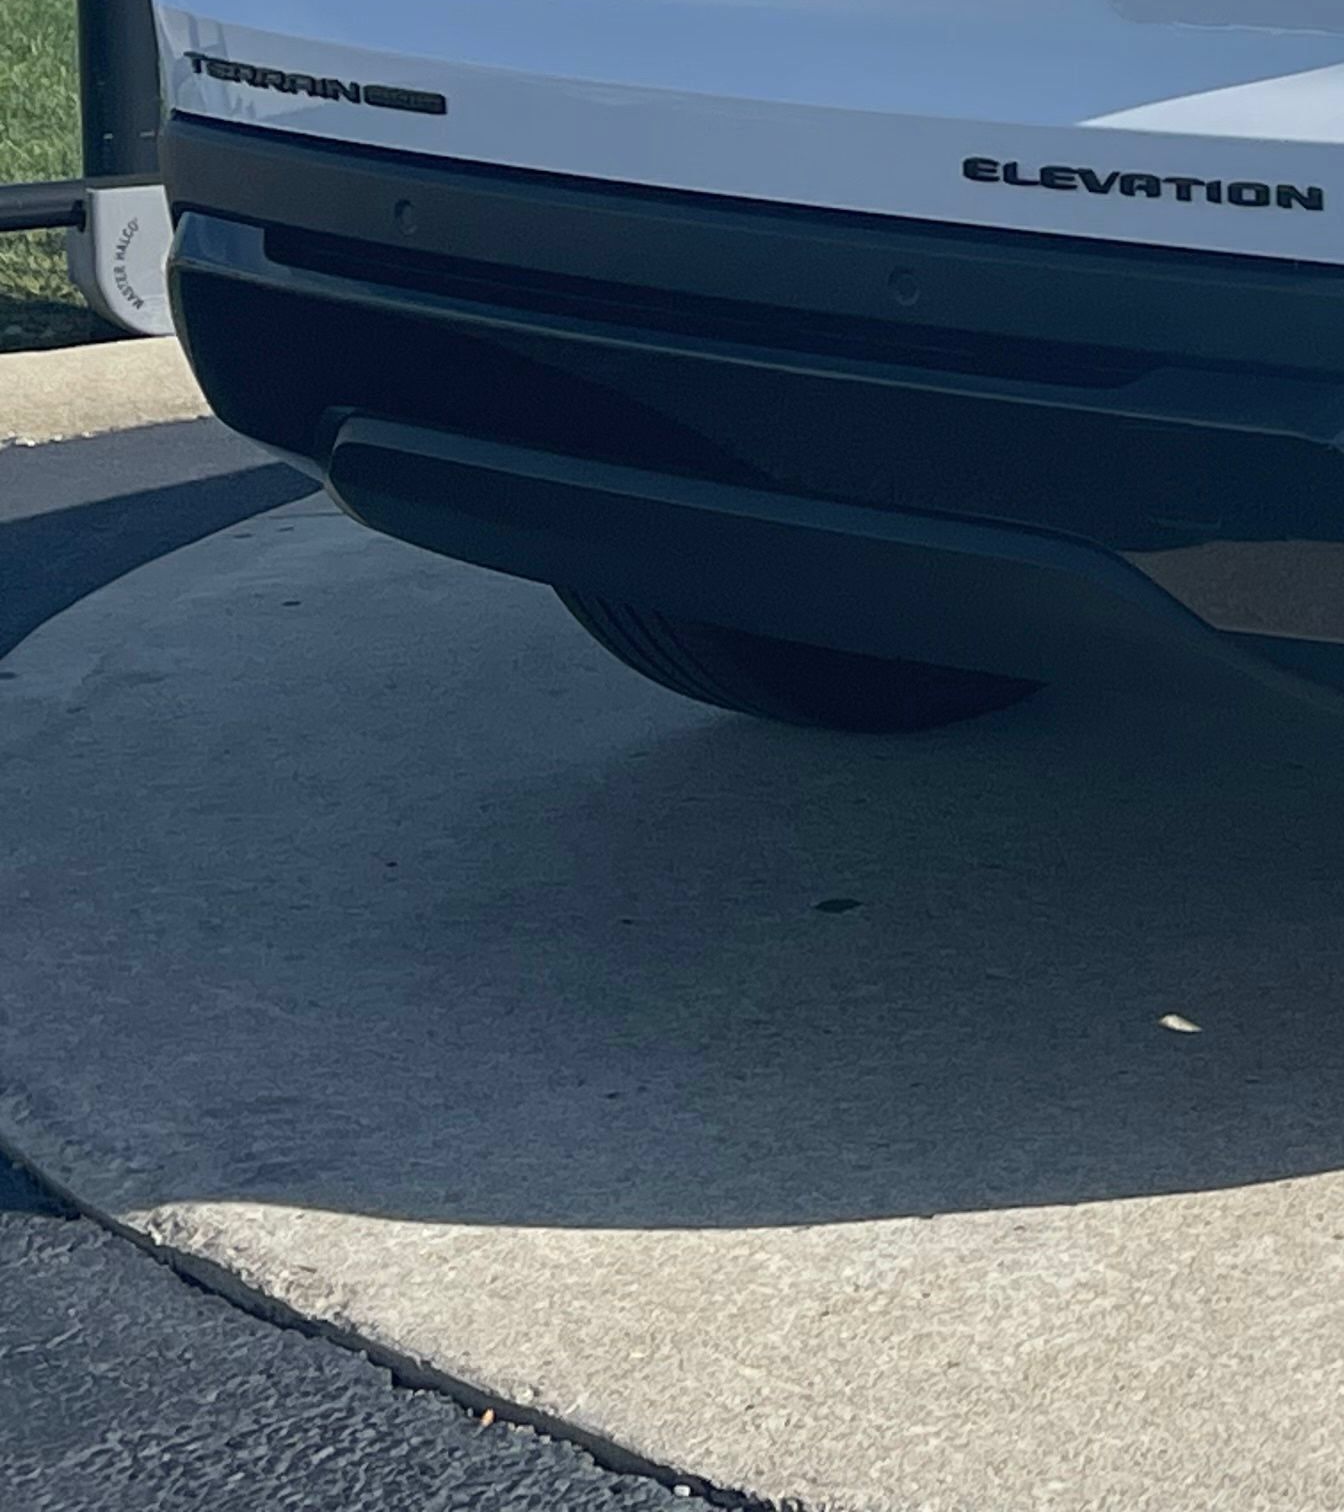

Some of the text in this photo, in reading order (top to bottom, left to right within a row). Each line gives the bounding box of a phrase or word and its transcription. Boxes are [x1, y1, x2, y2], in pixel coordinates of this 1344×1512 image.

[183, 50, 361, 104] TERRAIN
[962, 156, 1324, 211] ELEVATION
[113, 265, 145, 311] MASTER
